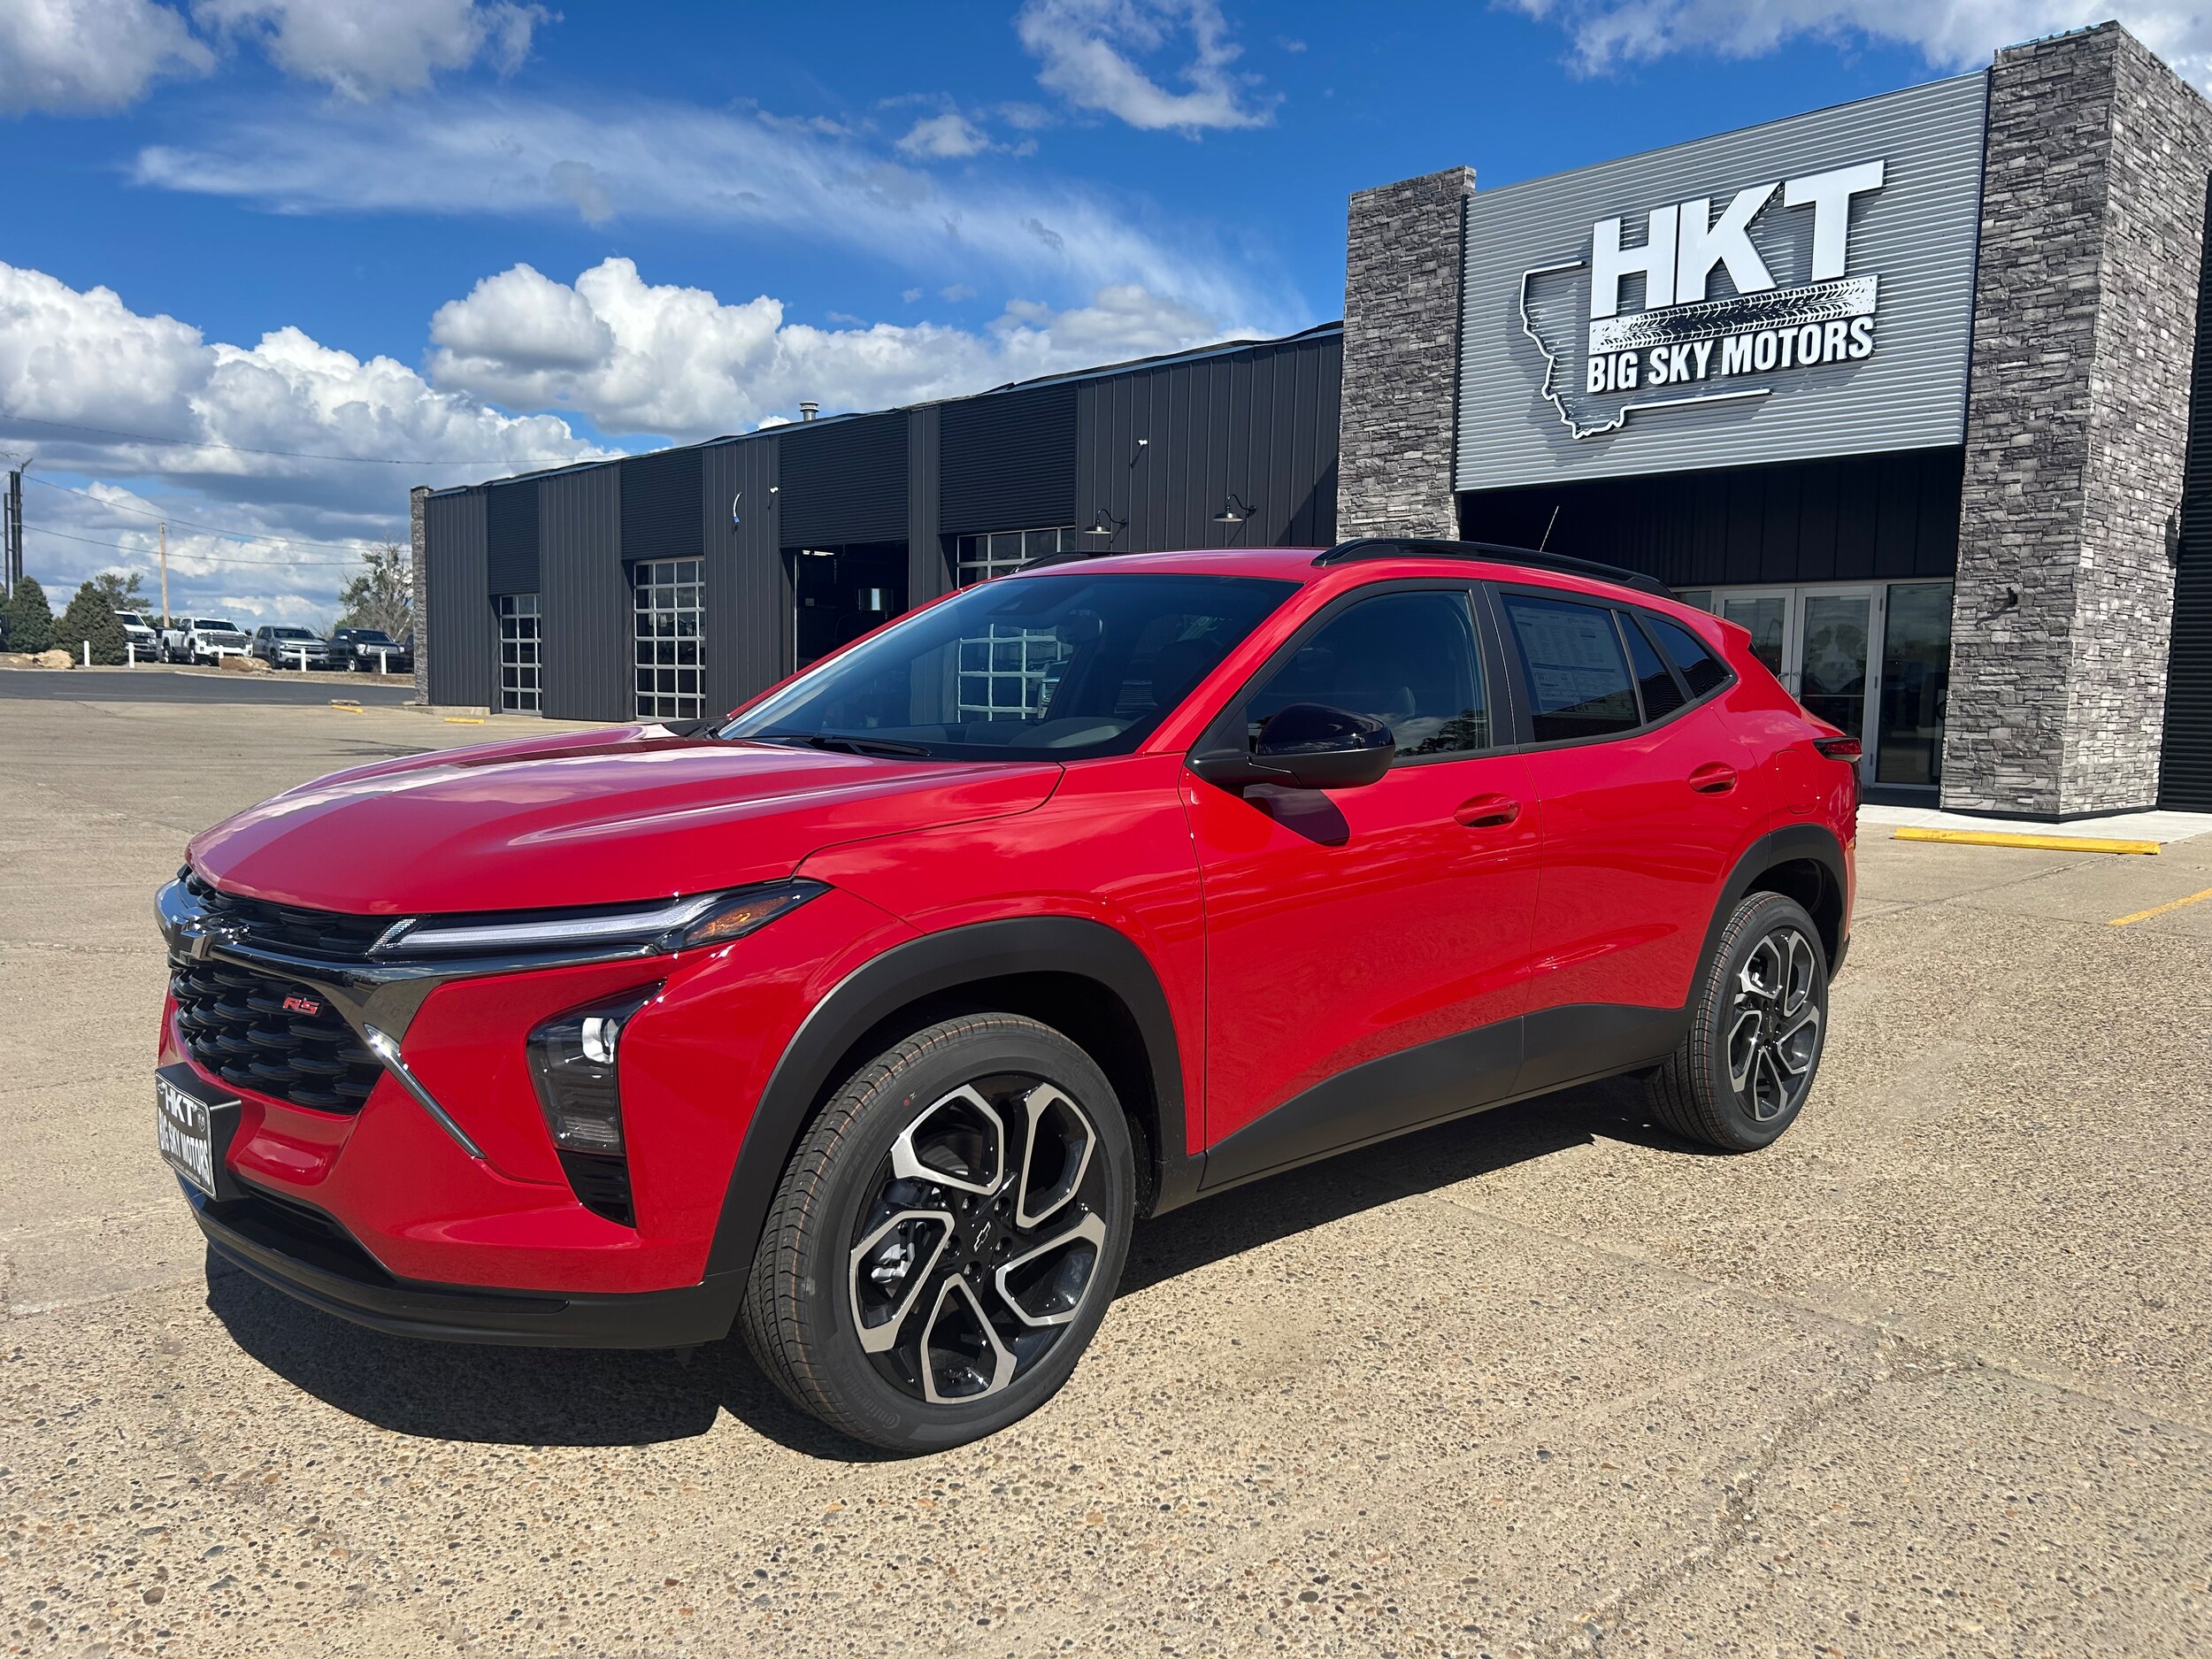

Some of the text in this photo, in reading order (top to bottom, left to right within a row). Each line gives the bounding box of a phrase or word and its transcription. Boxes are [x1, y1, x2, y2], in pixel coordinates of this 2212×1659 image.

[1590, 159, 1886, 319] HKT
[1586, 315, 1876, 393] BIG SKY MOTORS
[283, 996, 320, 1015] RS
[165, 1083, 195, 1127] HKT
[168, 1120, 181, 1158] SKY
[180, 1132, 211, 1186] MOTORS
